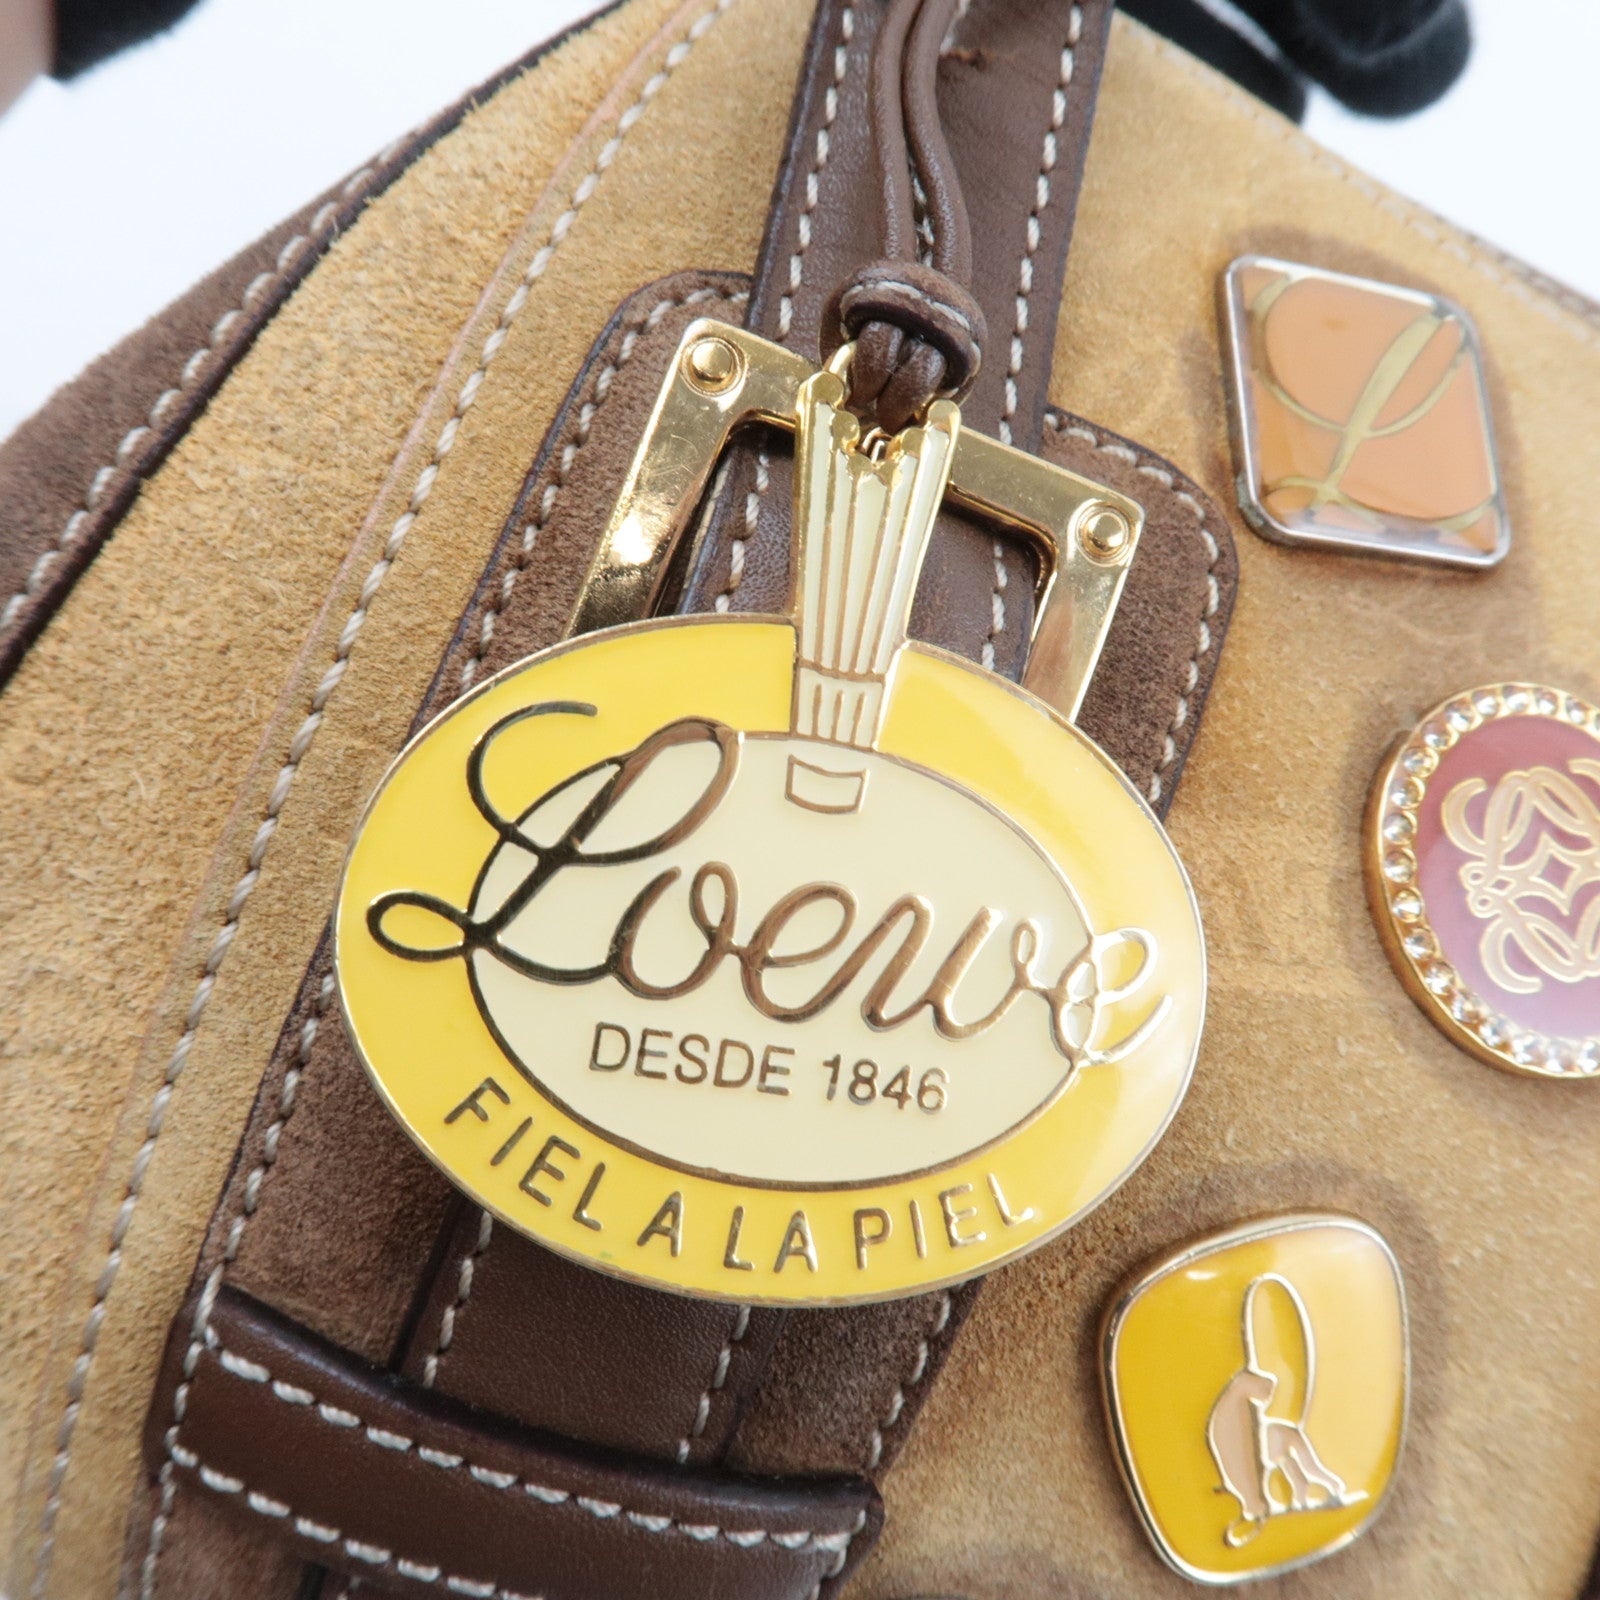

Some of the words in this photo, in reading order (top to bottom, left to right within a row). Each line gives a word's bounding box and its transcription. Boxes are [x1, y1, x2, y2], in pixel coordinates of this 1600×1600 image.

[366, 701, 1173, 1068] Loewe
[588, 1021, 797, 1097] DESDE
[821, 1053, 951, 1115] 1846
[443, 1076, 605, 1232] FIEL
[636, 1190, 685, 1258] A
[723, 1205, 820, 1274] LA
[852, 1171, 1035, 1271] PIEL
